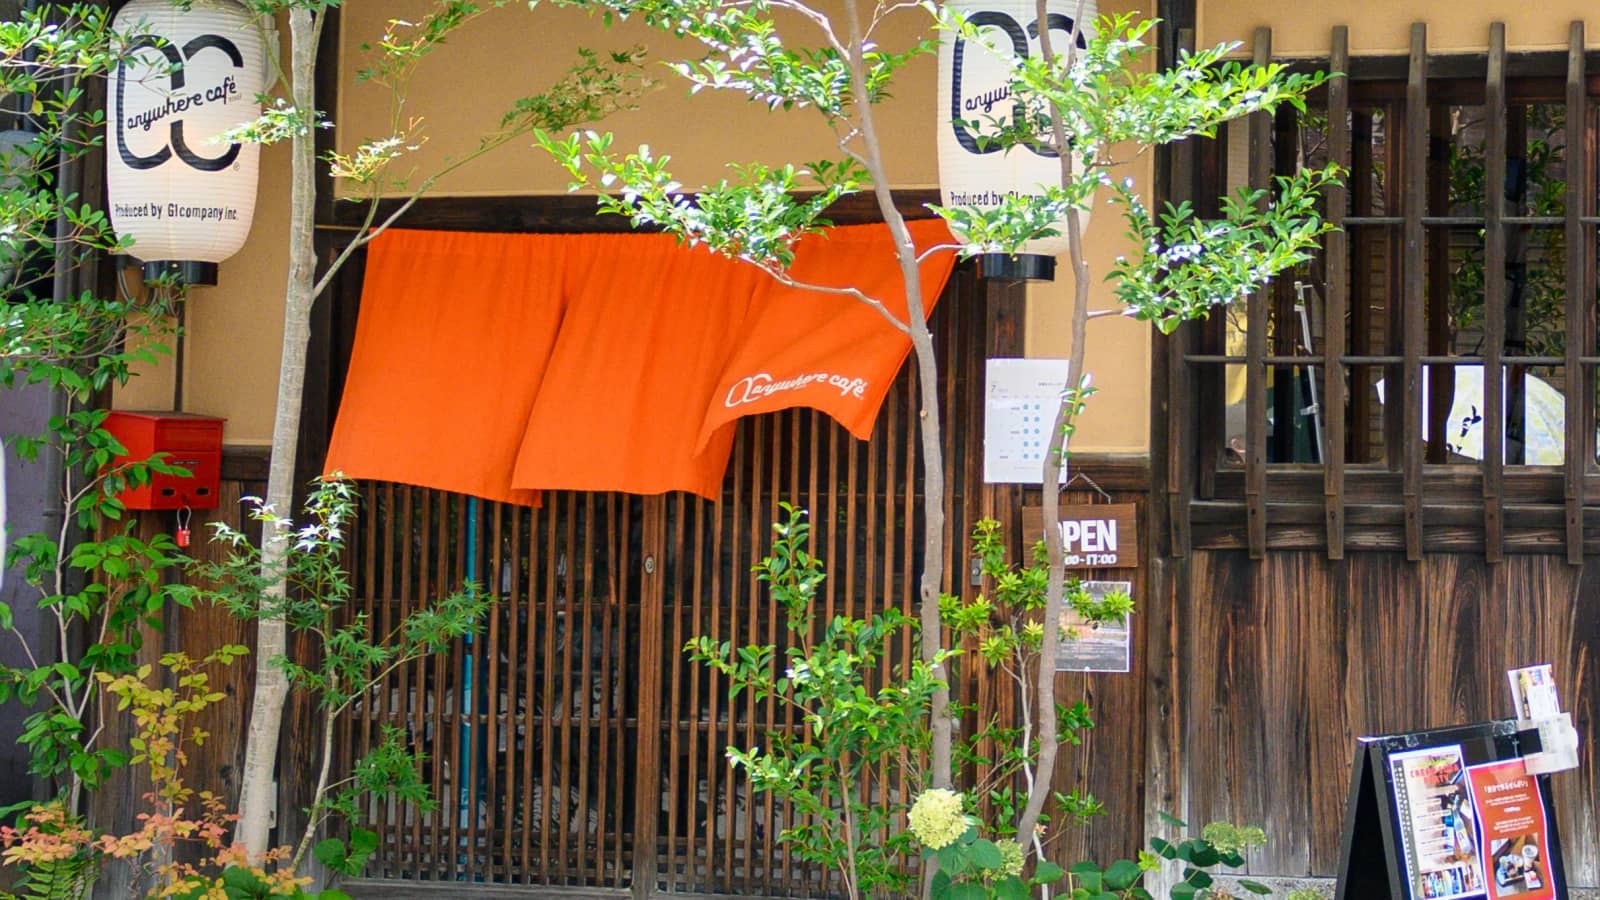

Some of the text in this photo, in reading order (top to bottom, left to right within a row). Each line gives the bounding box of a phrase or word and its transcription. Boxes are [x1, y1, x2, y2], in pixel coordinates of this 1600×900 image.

[127, 75, 237, 131] anywhere café
[965, 77, 1011, 113] anyw
[950, 191, 989, 206] Produced
[115, 203, 148, 218] Produced
[151, 203, 163, 219] by
[829, 374, 868, 397] café
